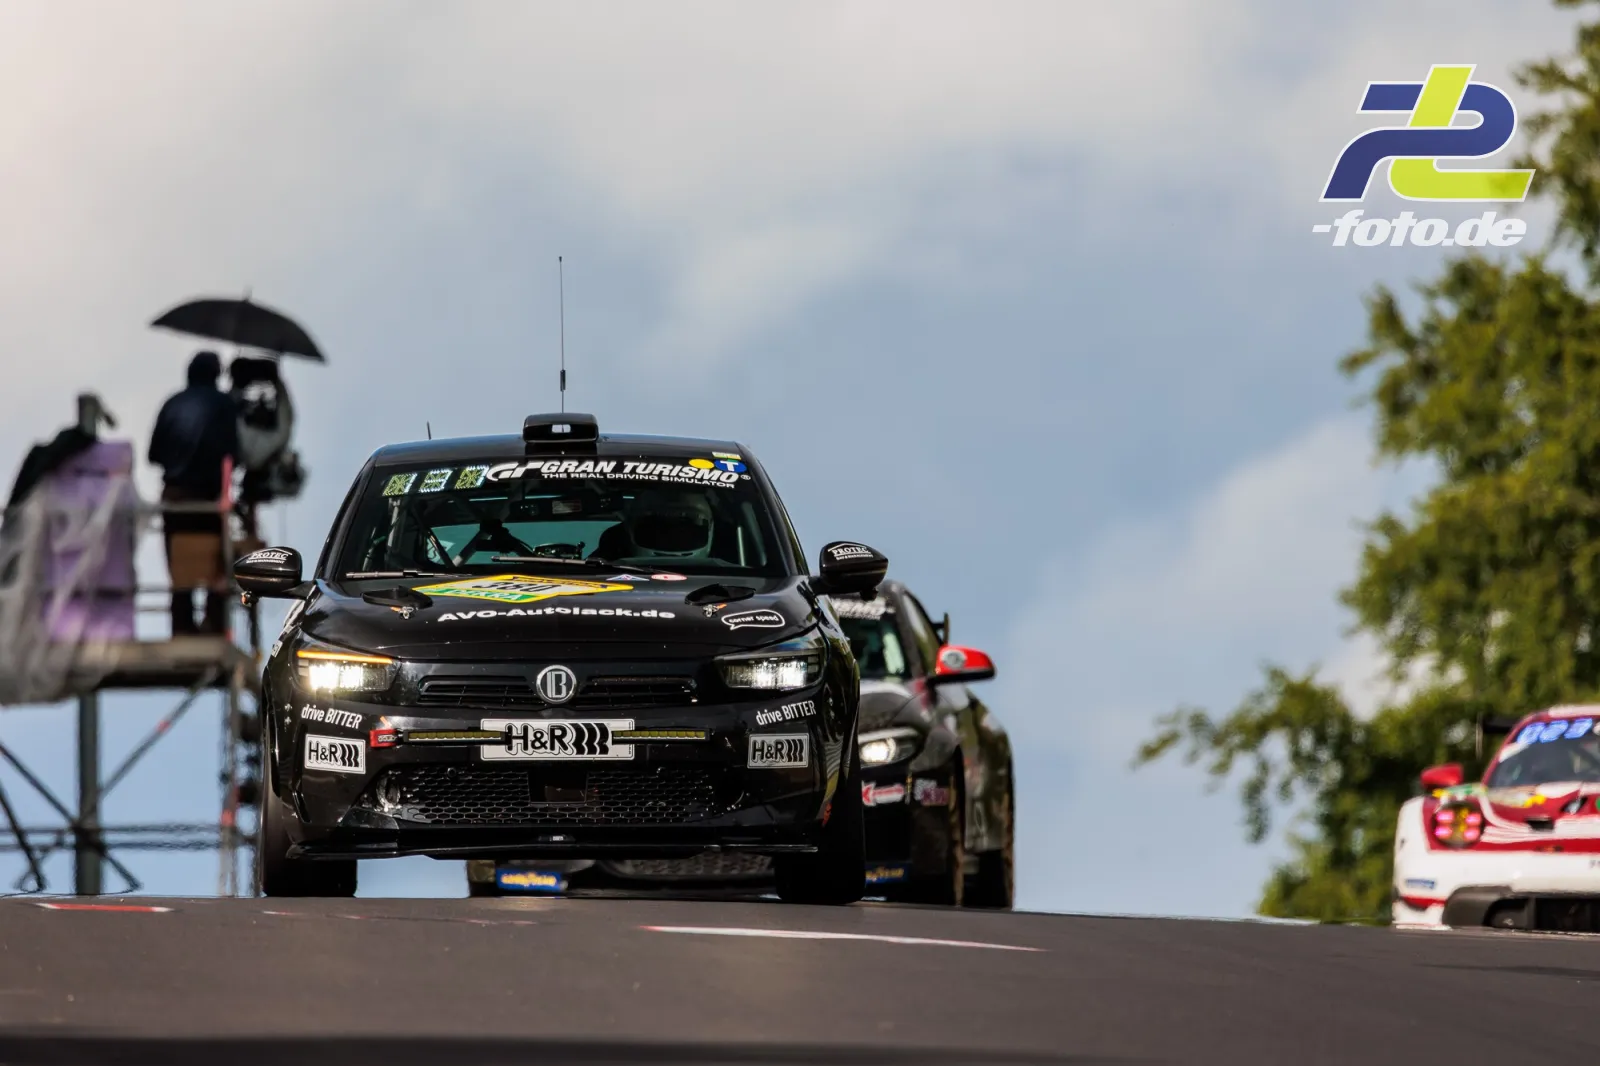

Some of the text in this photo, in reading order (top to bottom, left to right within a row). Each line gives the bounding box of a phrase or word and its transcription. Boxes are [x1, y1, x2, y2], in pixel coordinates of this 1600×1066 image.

[540, 460, 617, 474] GRAN
[622, 461, 739, 483] TURISMO
[606, 473, 658, 481] DRIVING
[661, 475, 735, 488] SIMULATOR
[437, 606, 676, 622] AVO-Autolack.de
[301, 704, 363, 729] drive BITTER
[755, 700, 817, 725] drive BITTER
[505, 723, 572, 753] H&R
[308, 740, 340, 763] H&R
[752, 740, 785, 761] H&R
